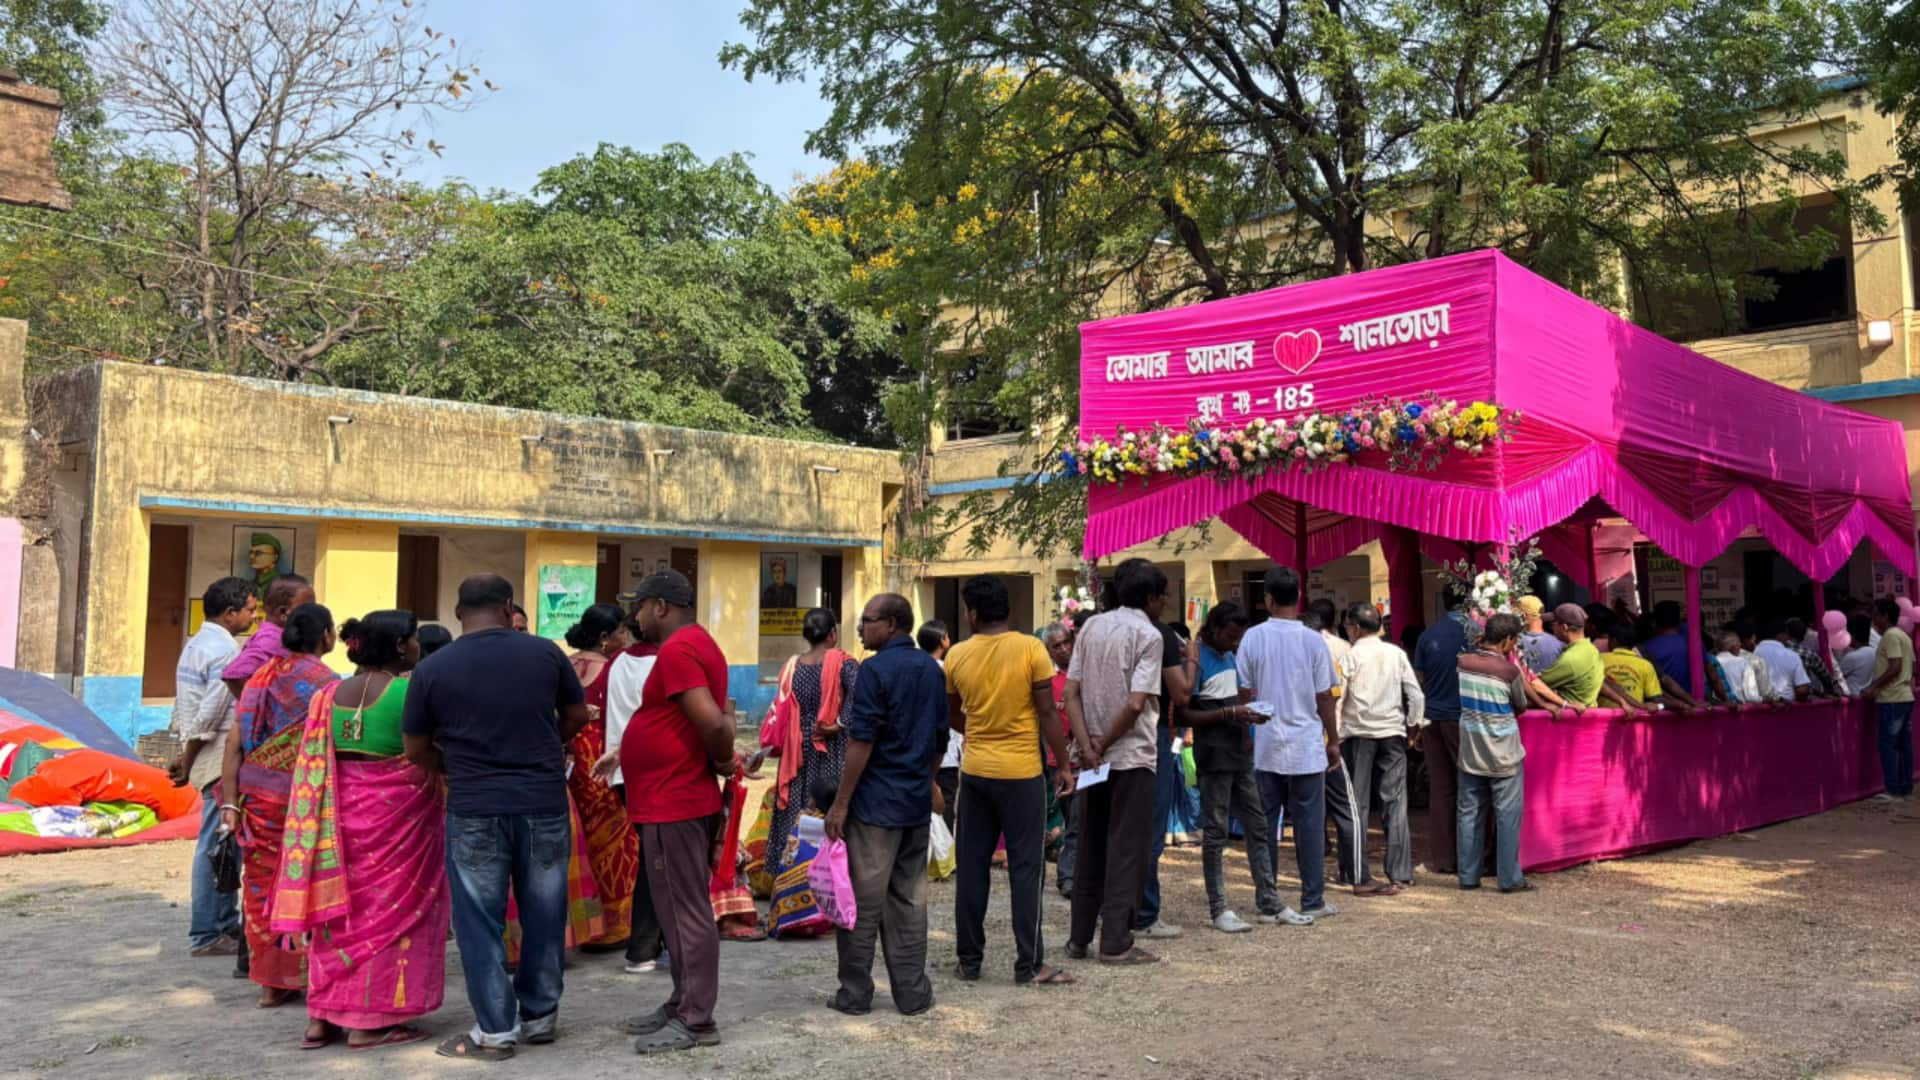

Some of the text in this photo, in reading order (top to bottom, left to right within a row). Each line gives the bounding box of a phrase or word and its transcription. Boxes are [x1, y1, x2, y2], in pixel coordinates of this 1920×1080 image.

[1106, 303, 1451, 382] তোমার আমার শালতোড়া
[1196, 393, 1224, 423] বুথ
